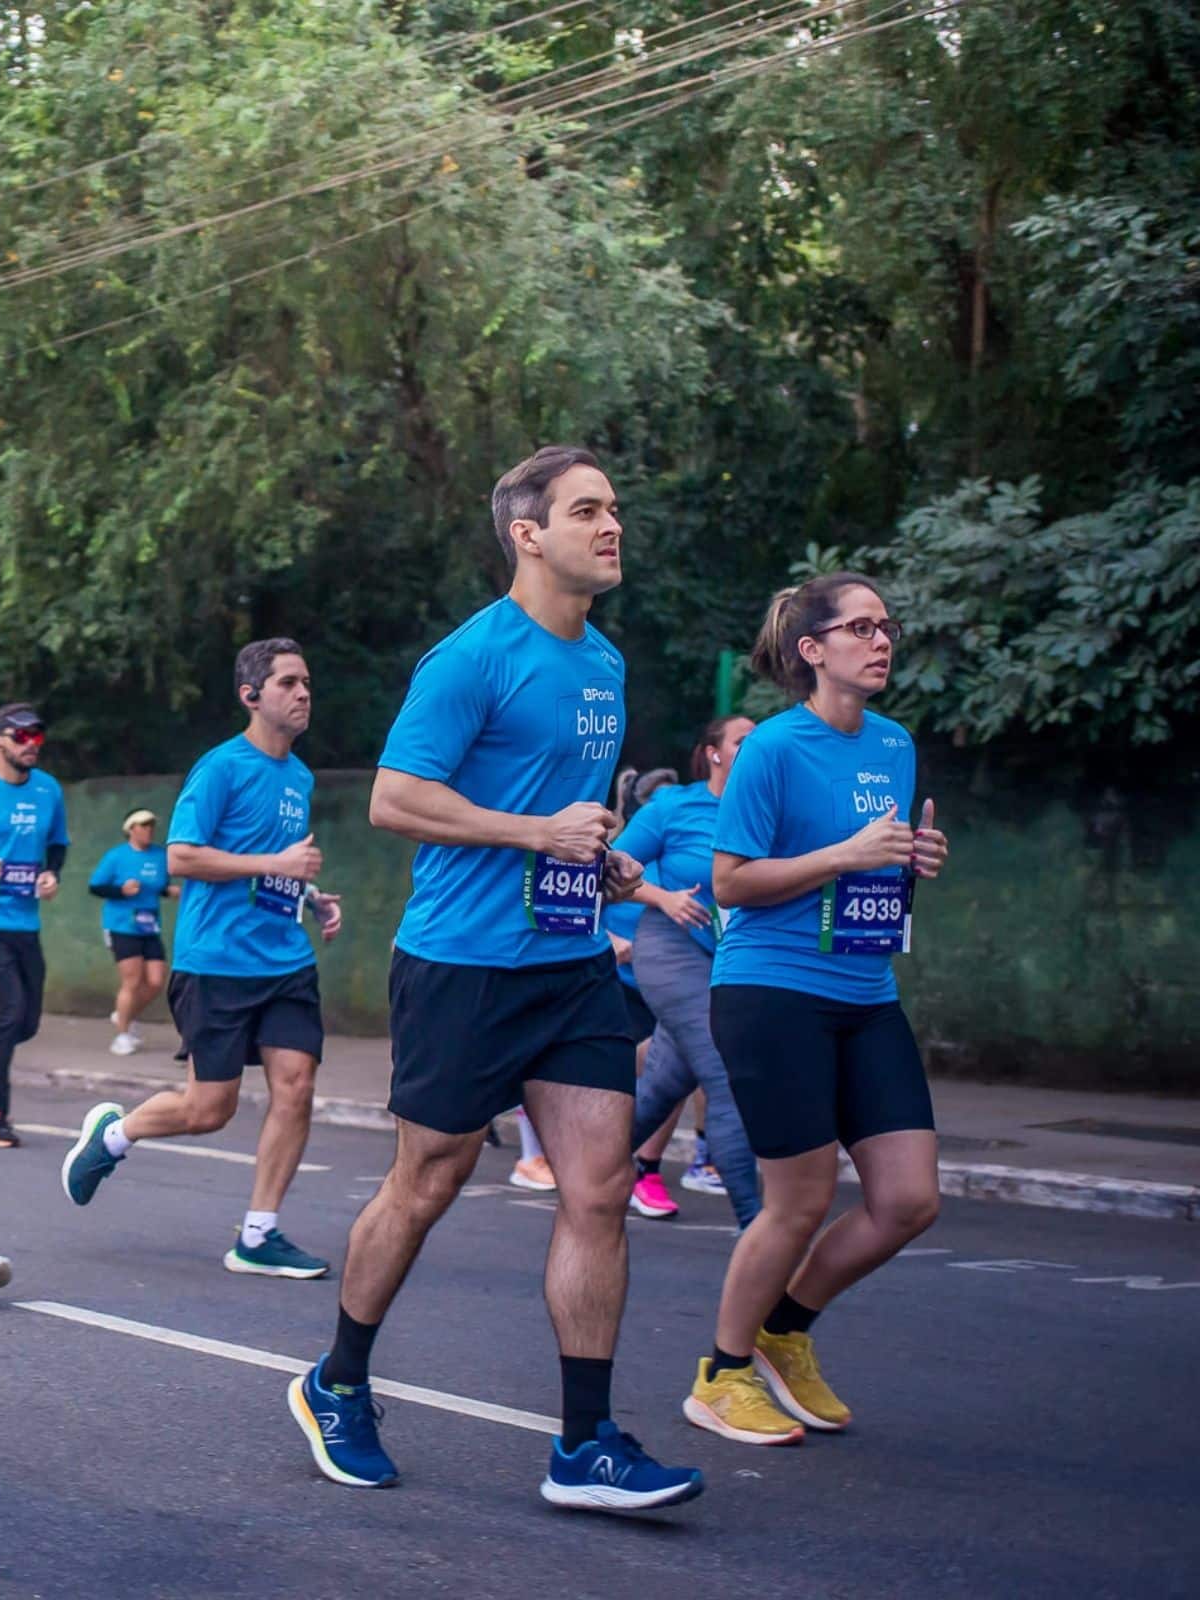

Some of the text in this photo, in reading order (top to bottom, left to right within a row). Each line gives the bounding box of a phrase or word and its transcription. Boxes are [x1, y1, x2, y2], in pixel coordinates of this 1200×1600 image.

[576, 708, 618, 736] blue
[581, 739, 616, 761] run
[279, 799, 304, 820] blue
[852, 789, 896, 814] blue
[524, 870, 532, 907] VERDE
[539, 870, 597, 899] 4940
[821, 899, 832, 931] VERDE
[843, 897, 902, 921] 4939
